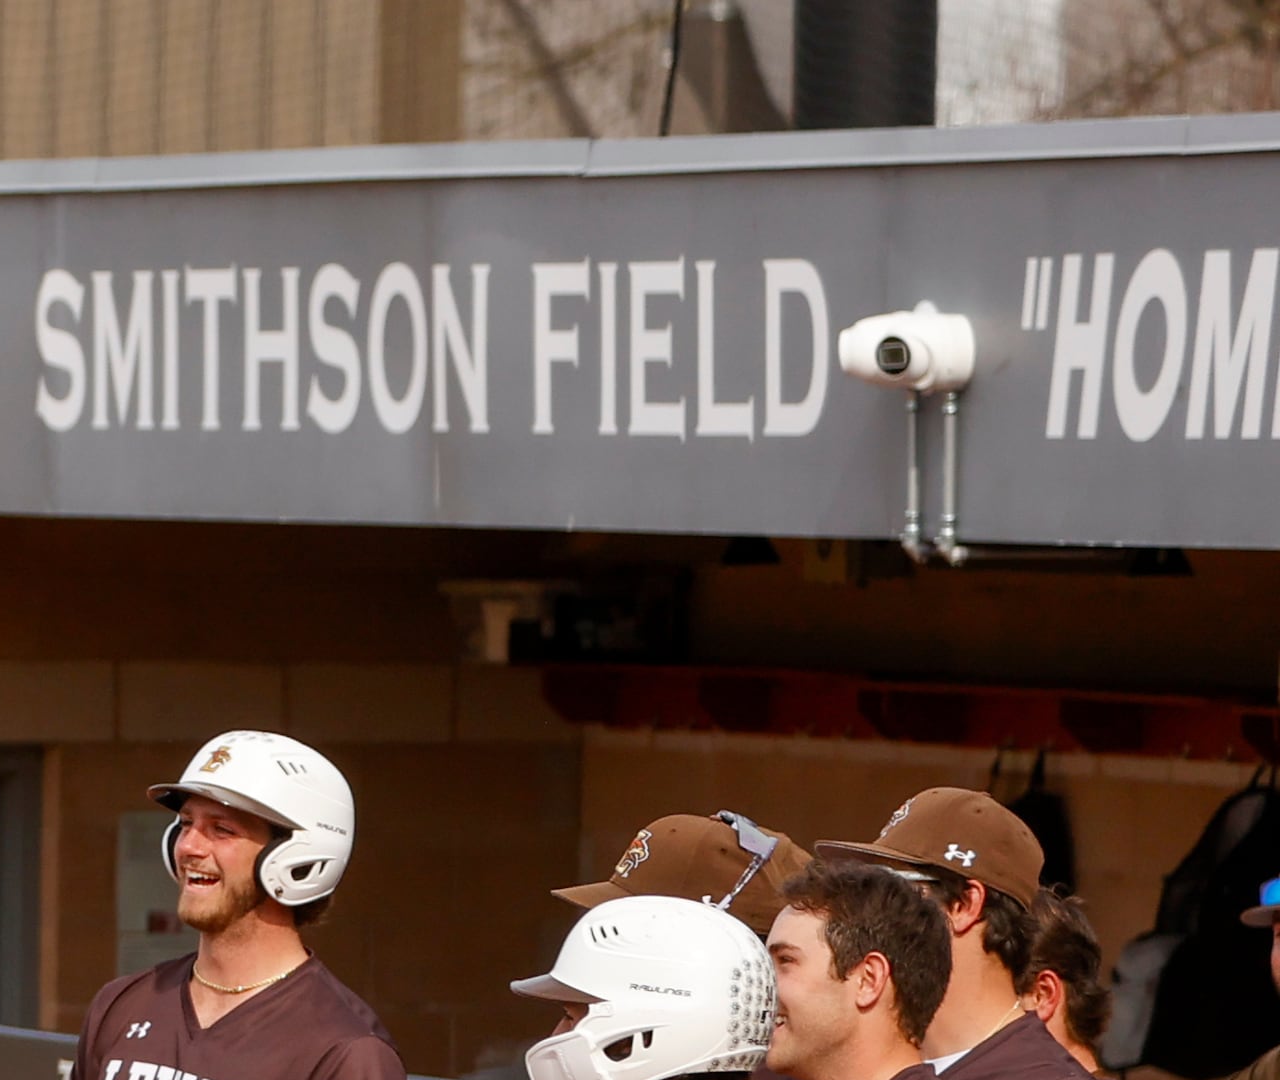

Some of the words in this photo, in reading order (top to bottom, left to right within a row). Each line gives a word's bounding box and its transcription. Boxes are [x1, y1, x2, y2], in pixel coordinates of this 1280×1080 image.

[35, 262, 491, 434] SMITHSON
[531, 254, 830, 443] FIELD
[1021, 248, 1280, 442] "HOM
[629, 982, 692, 997] RAWLINGS
